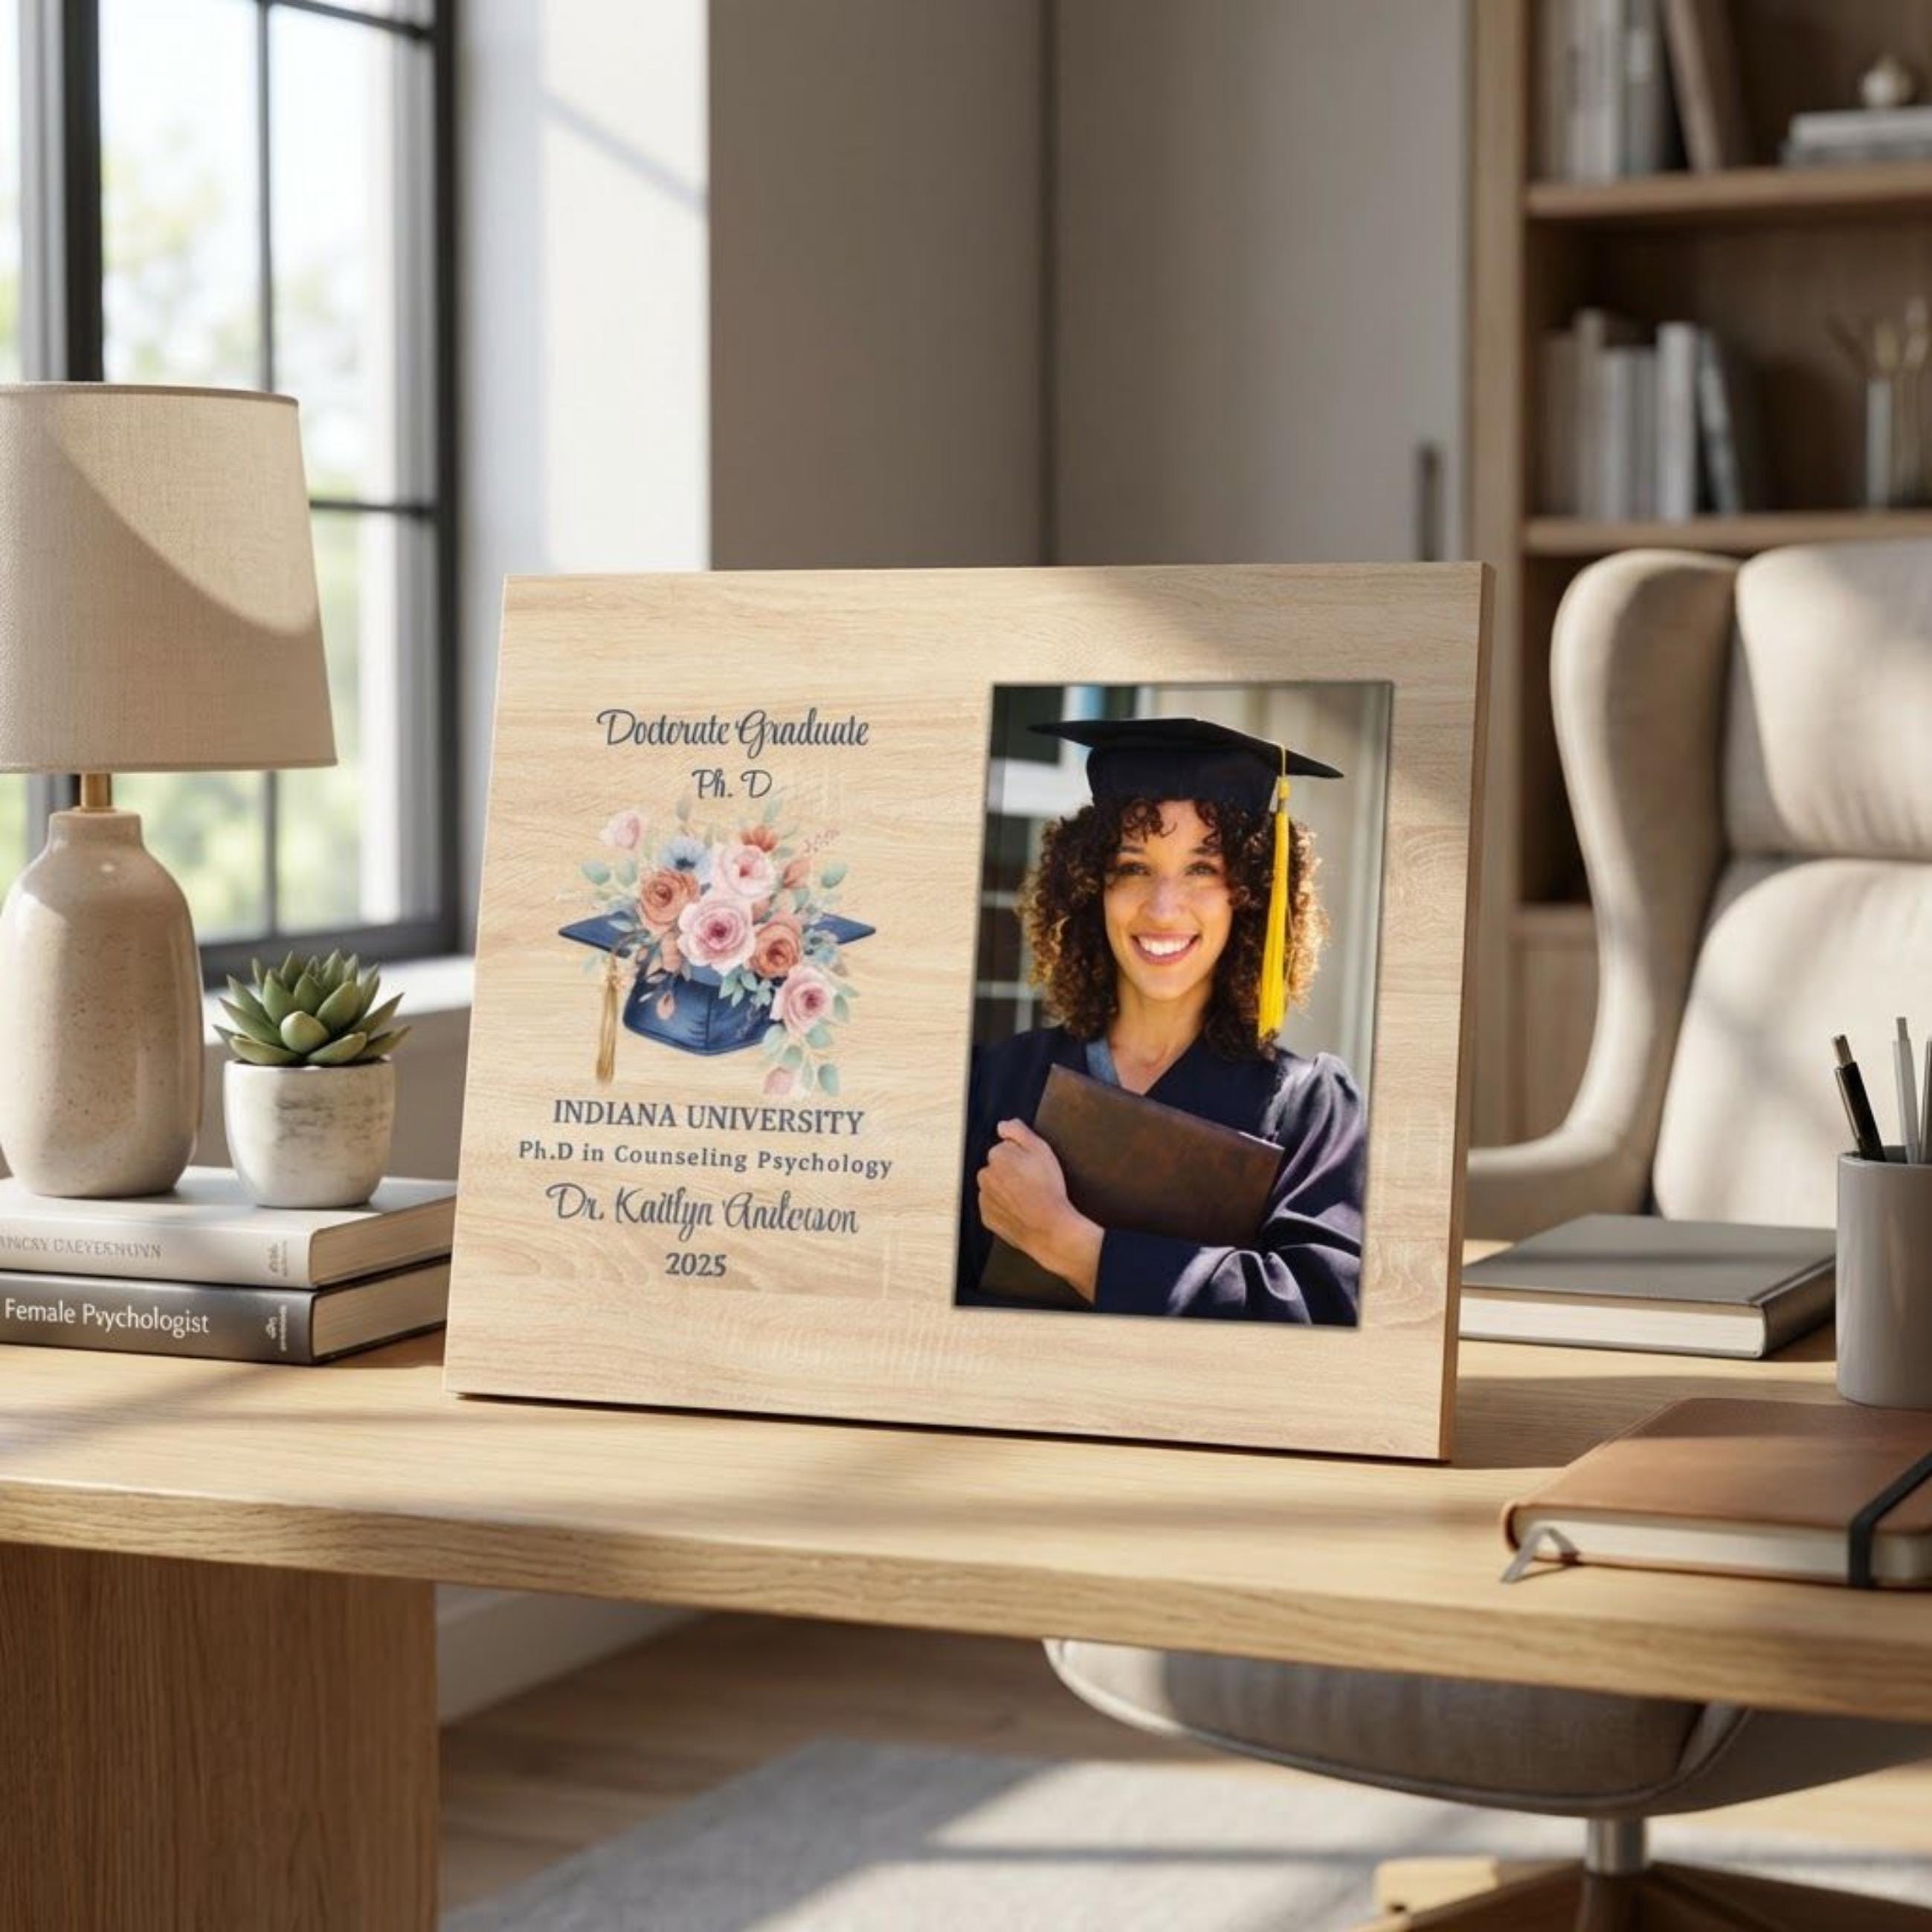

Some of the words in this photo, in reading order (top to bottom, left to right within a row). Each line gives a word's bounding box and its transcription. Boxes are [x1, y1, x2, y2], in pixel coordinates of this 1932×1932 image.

[596, 709, 730, 746] Doctorate
[735, 707, 869, 759] Graduate
[692, 768, 734, 799] Ph.
[739, 770, 773, 799] D
[553, 1099, 677, 1127] INDIANA
[686, 1104, 866, 1136] UNIVERSITY
[518, 1139, 574, 1162] Ph.D
[582, 1142, 604, 1162] in
[614, 1144, 748, 1173] Counseling
[757, 1150, 894, 1180] Psychology
[546, 1182, 605, 1220] Dr.
[615, 1186, 713, 1242] Kaitlyn
[721, 1190, 859, 1234] Anderson
[665, 1252, 728, 1277] 2025
[4, 1297, 76, 1324] Female
